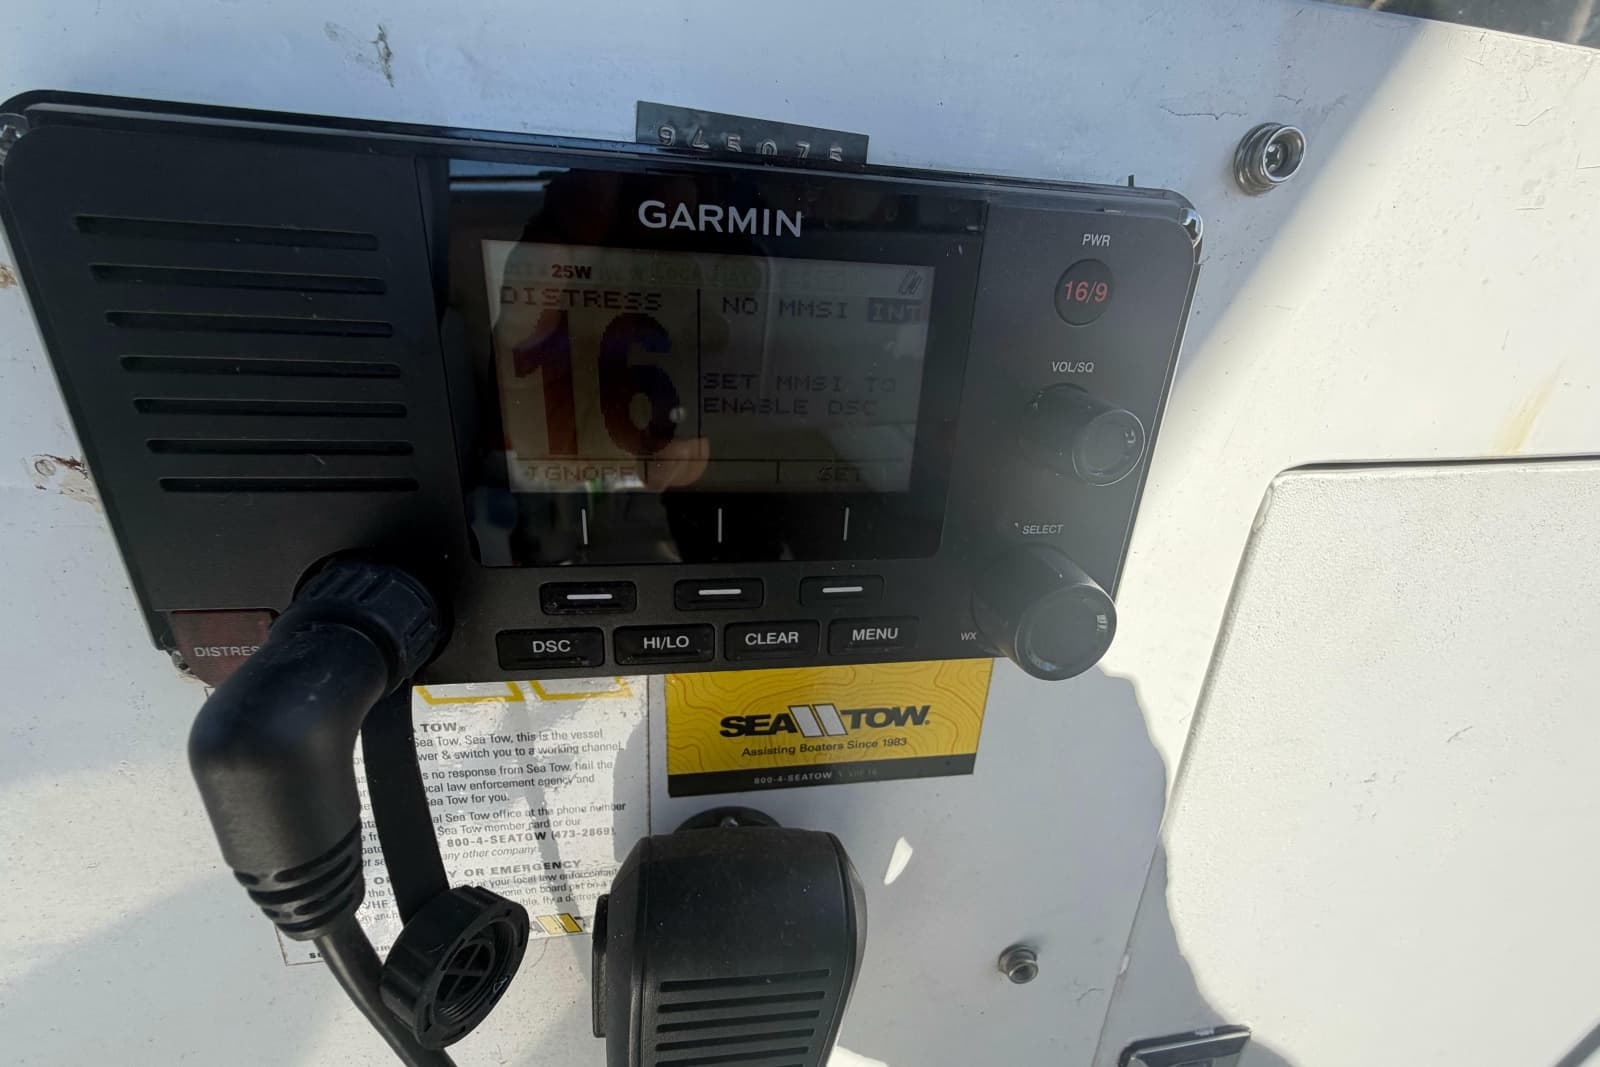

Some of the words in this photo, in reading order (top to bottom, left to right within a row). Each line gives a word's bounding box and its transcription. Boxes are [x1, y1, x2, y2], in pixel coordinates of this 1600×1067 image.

[638, 200, 802, 237] GARMIN
[1082, 233, 1110, 247] PWR
[551, 264, 592, 279] 25W
[500, 286, 662, 311] DISTRESS
[1064, 281, 1108, 303] 16/9
[722, 297, 758, 316] NO
[779, 301, 848, 319] MMSI
[1051, 361, 1094, 373] VOL/SQ
[512, 309, 680, 456] 16
[703, 372, 757, 390] SET
[777, 376, 841, 392] MMSI
[703, 398, 808, 415] ENABLE
[1022, 524, 1064, 535] SELECT
[744, 631, 799, 645] CLEAR
[851, 627, 899, 641] MENU
[960, 632, 977, 640] WX
[532, 639, 571, 654] DSC
[643, 635, 690, 650] HI/LO
[193, 645, 262, 657] DISTRES
[719, 712, 799, 738] SEA
[465, 733, 486, 745] Sea
[516, 730, 536, 742] this
[551, 730, 568, 740] the
[570, 728, 603, 739] vessel
[418, 751, 438, 761] wer
[442, 750, 451, 760] &
[455, 747, 489, 760] switch
[493, 748, 512, 760] you
[515, 747, 525, 757] to
[742, 744, 796, 757] Assisting
[800, 741, 844, 753] Boaters
[847, 739, 878, 750] Since
[883, 736, 907, 747] 1983
[432, 769, 445, 778] no
[448, 766, 496, 780] response
[499, 764, 523, 775] from
[526, 763, 546, 773] Sea
[597, 758, 613, 769] the
[425, 781, 443, 793] ocal
[447, 781, 466, 791] law
[469, 776, 535, 791] enforcement
[753, 770, 833, 784] 800-4-SEATOW
[446, 794, 468, 805] Tow
[471, 792, 487, 803] for
[433, 811, 442, 823] al
[446, 811, 466, 822] Sea
[470, 809, 490, 821] Tow
[493, 807, 522, 819] office
[538, 805, 553, 816] the
[557, 803, 587, 815] phone
[461, 823, 482, 834] Tow
[447, 831, 546, 847] 800-4-SEATOW
[463, 847, 488, 859] other
[464, 867, 484, 877] OR
[491, 860, 582, 874] EMERGENCY
